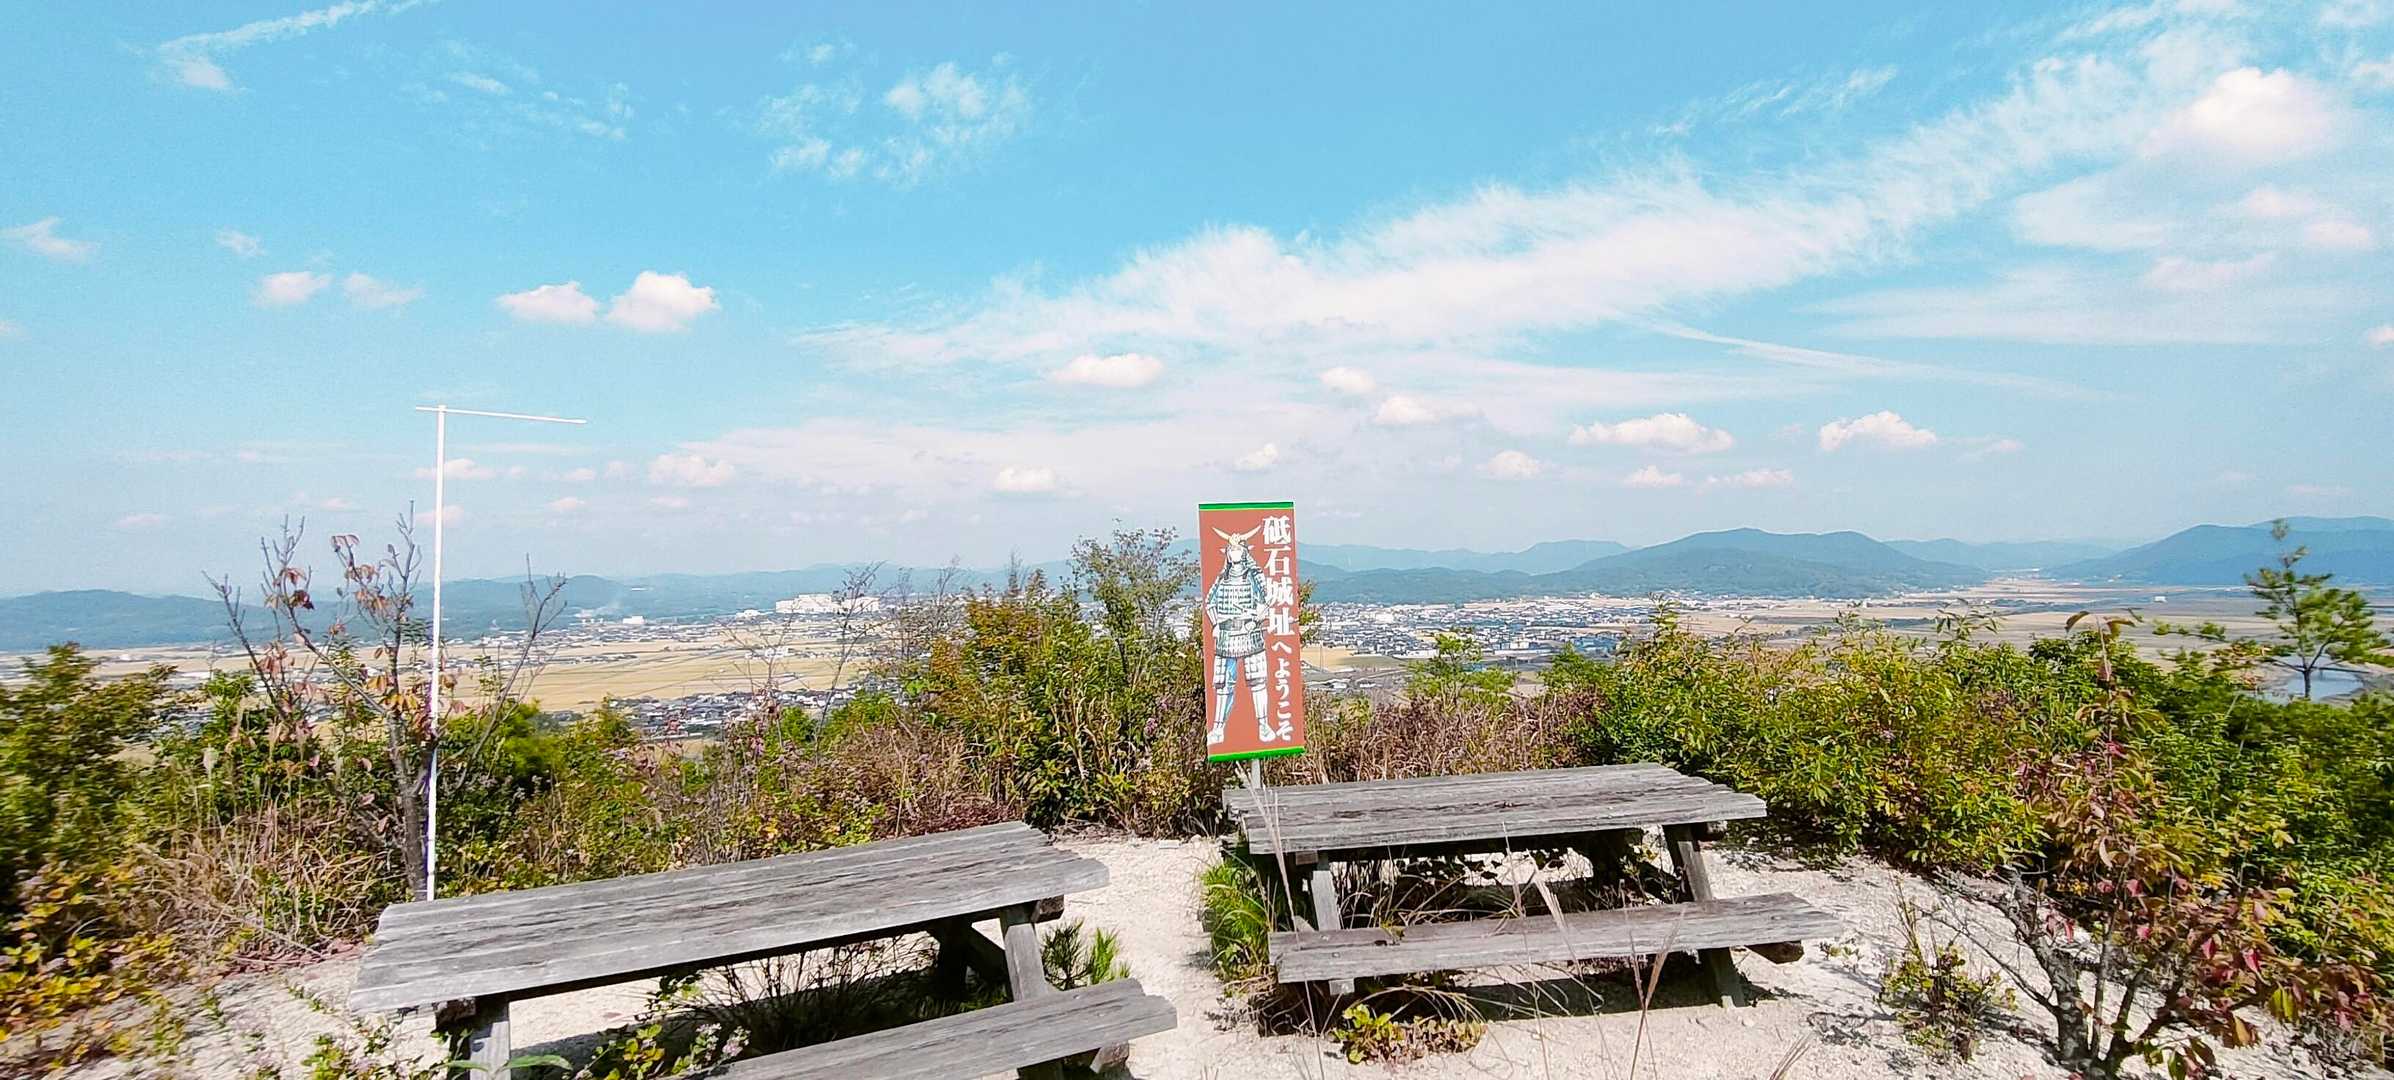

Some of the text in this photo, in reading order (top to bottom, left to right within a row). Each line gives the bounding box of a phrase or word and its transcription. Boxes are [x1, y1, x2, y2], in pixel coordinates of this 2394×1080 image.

[1263, 515, 1295, 741] 砥石城址へようこそ
